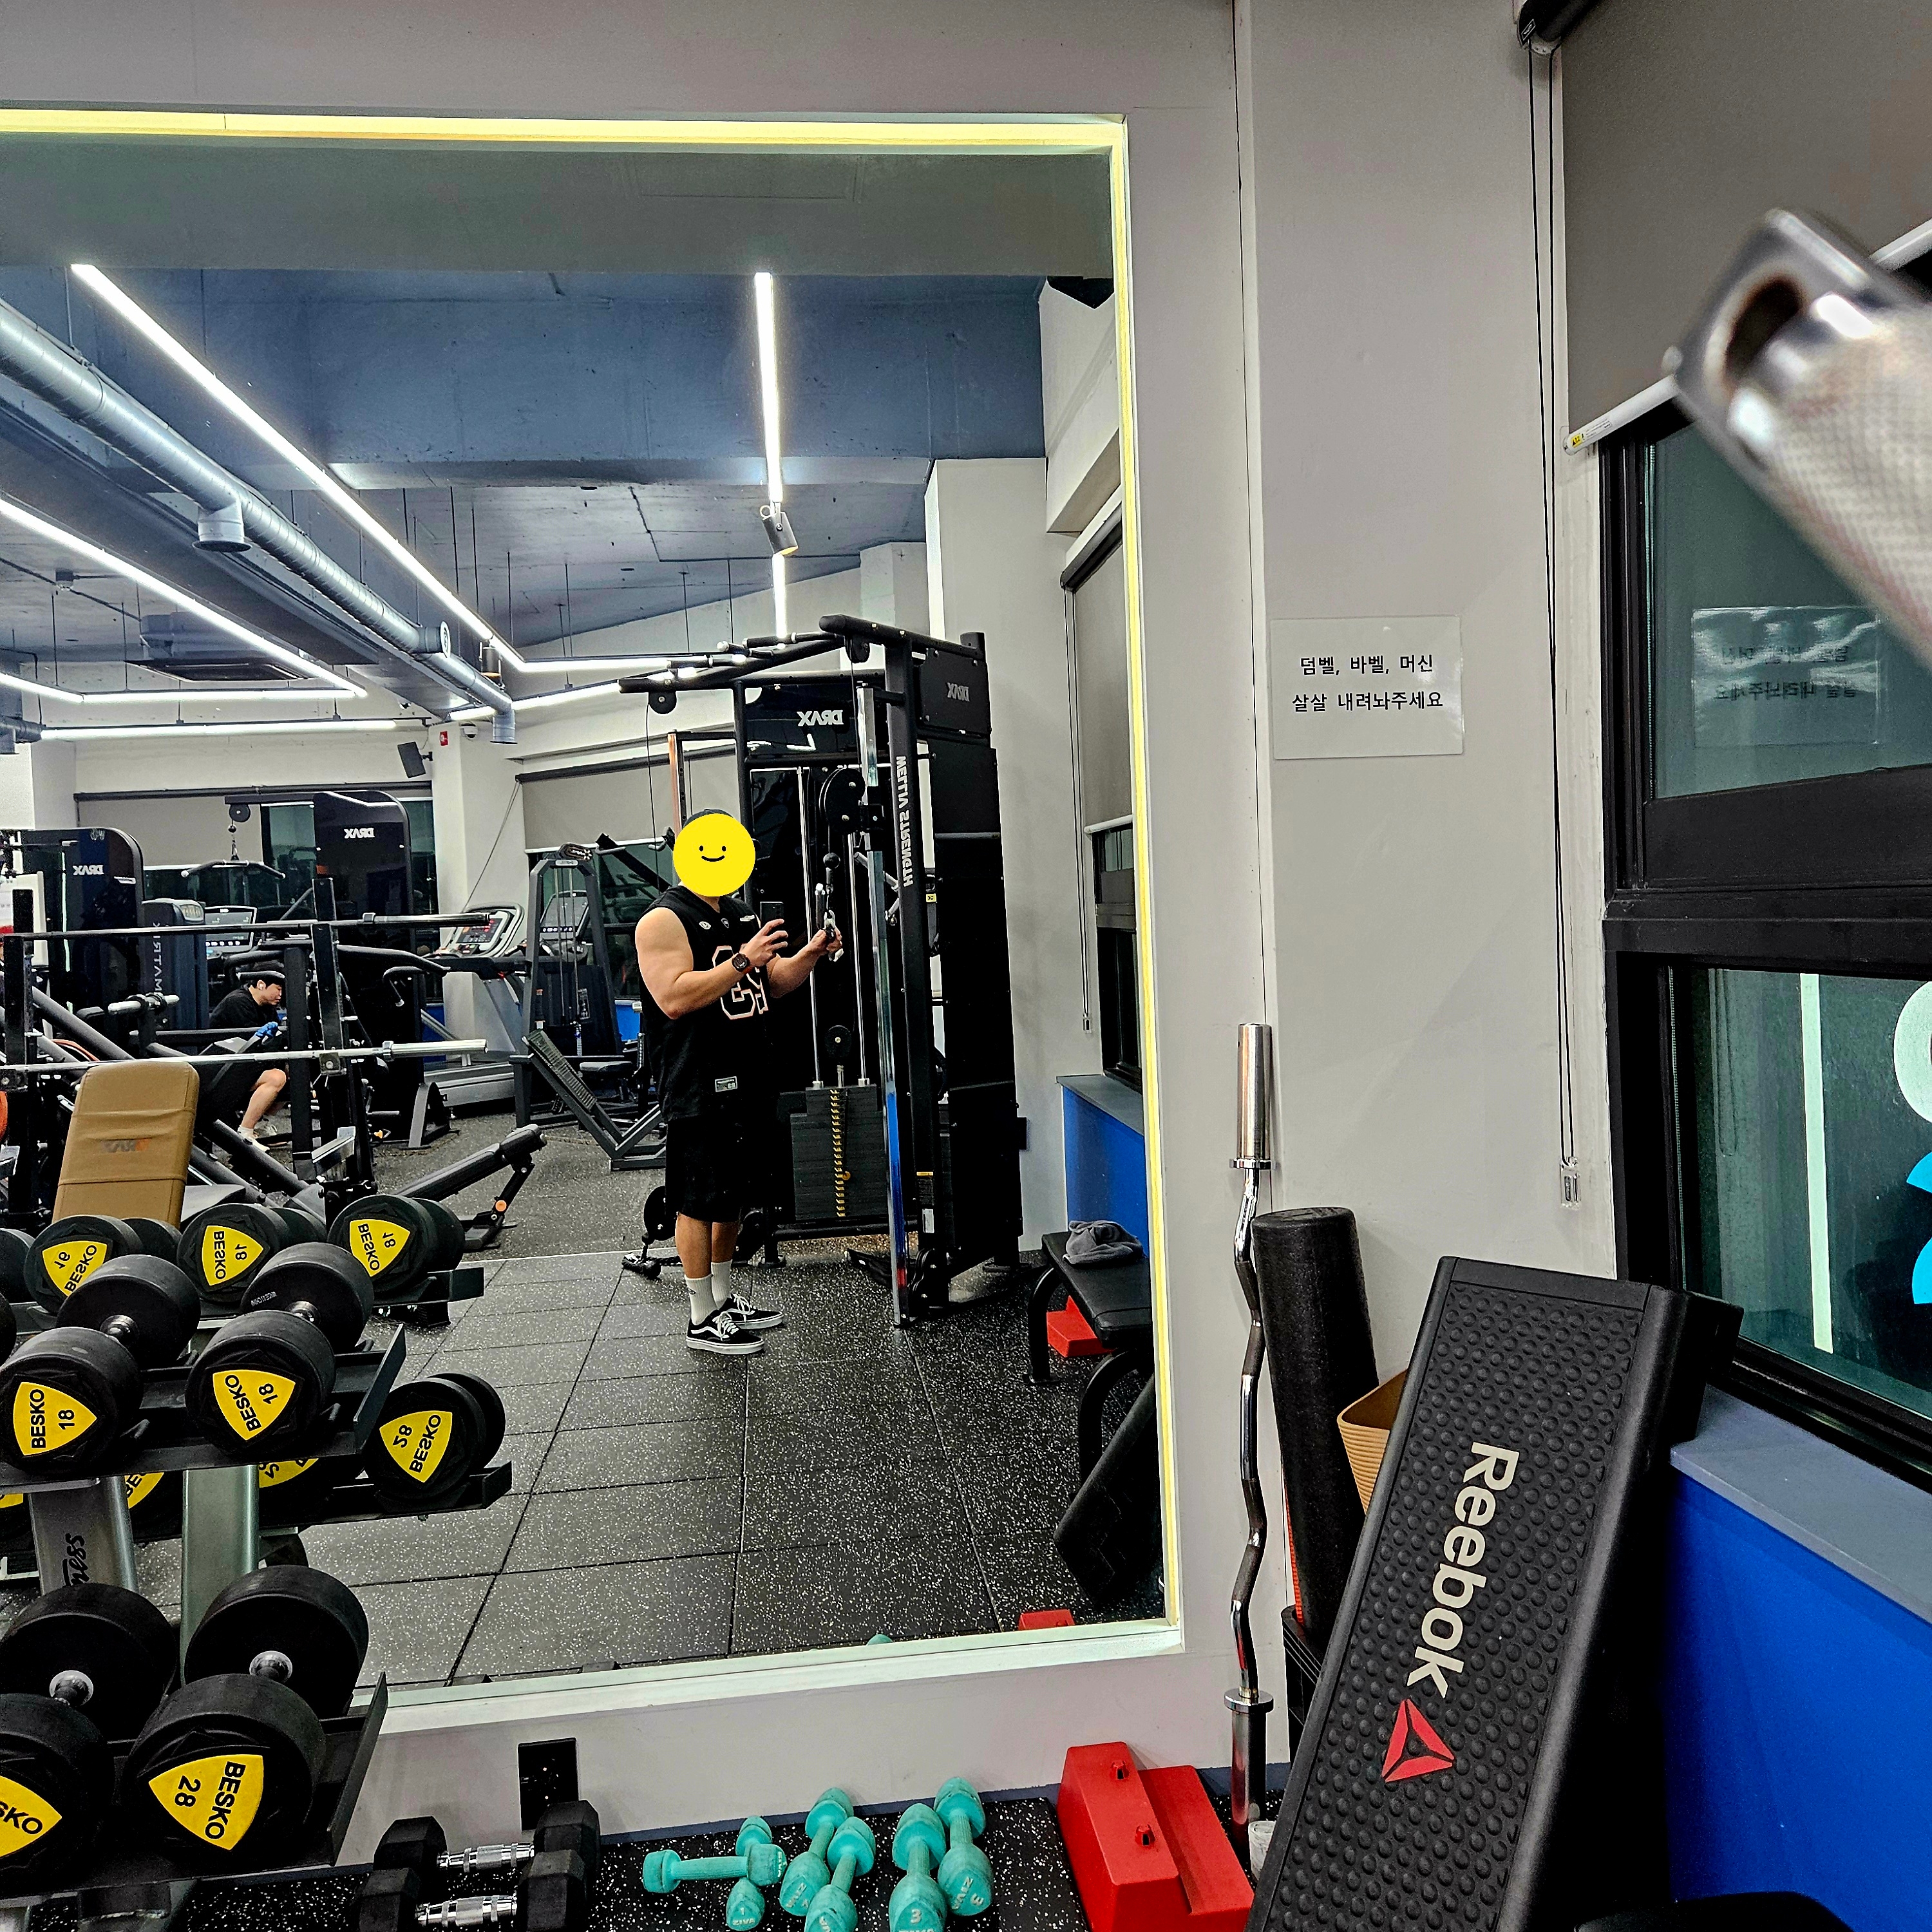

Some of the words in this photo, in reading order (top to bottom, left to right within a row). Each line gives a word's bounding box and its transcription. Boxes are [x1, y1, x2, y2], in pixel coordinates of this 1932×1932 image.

[1300, 656, 1340, 676] 덤벨,
[1350, 654, 1390, 674] 바벨,
[1399, 654, 1434, 673] 머신
[1292, 693, 1328, 712] 살살
[1338, 691, 1443, 711] 내려놔주세요
[225, 1374, 262, 1432] BESKO
[258, 1383, 278, 1405] 18
[29, 1388, 46, 1448] BESKO
[57, 1409, 75, 1430] 18
[1406, 1441, 1520, 1700] Reebok
[174, 1775, 202, 1808] 28
[204, 1761, 247, 1840] BESKO
[951, 1876, 974, 1910] ZIVA
[971, 1893, 984, 1906] 3
[732, 1917, 755, 1926] ZIVA
[910, 1908, 922, 1924] 3
